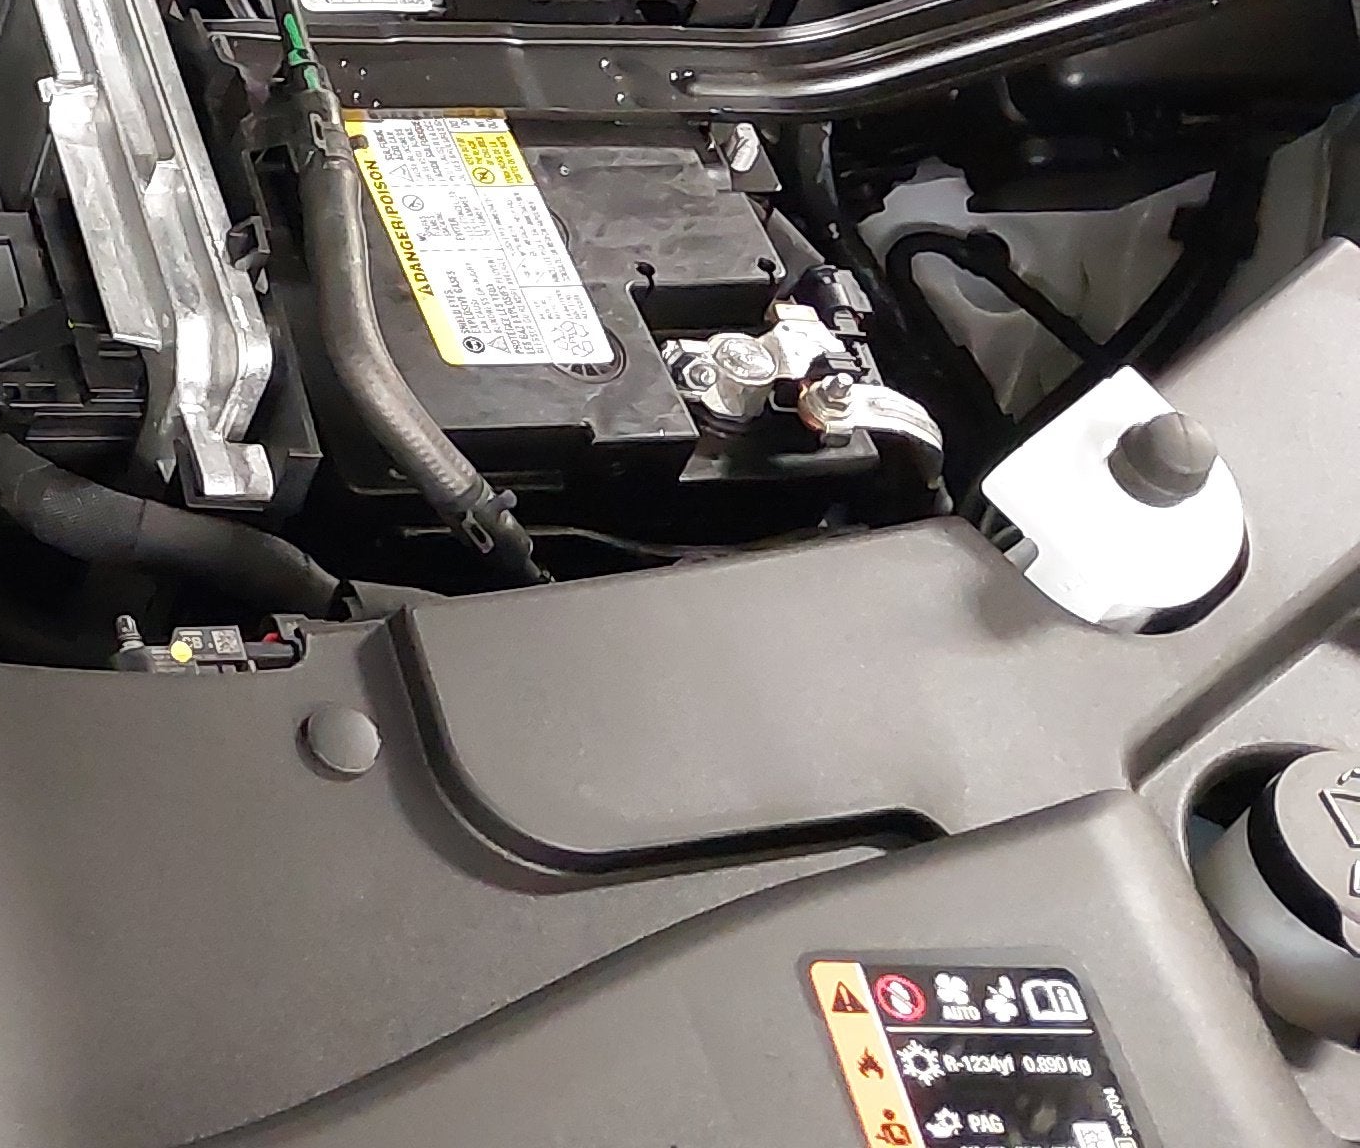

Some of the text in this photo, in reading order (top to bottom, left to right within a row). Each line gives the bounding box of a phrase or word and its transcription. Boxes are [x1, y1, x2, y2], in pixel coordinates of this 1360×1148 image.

[364, 160, 428, 282] DANGER/POISON
[942, 1005, 981, 1021] AUTO
[943, 1054, 1092, 1077] R-1234yf 0.890 kg
[967, 1113, 1005, 1133] PAG
